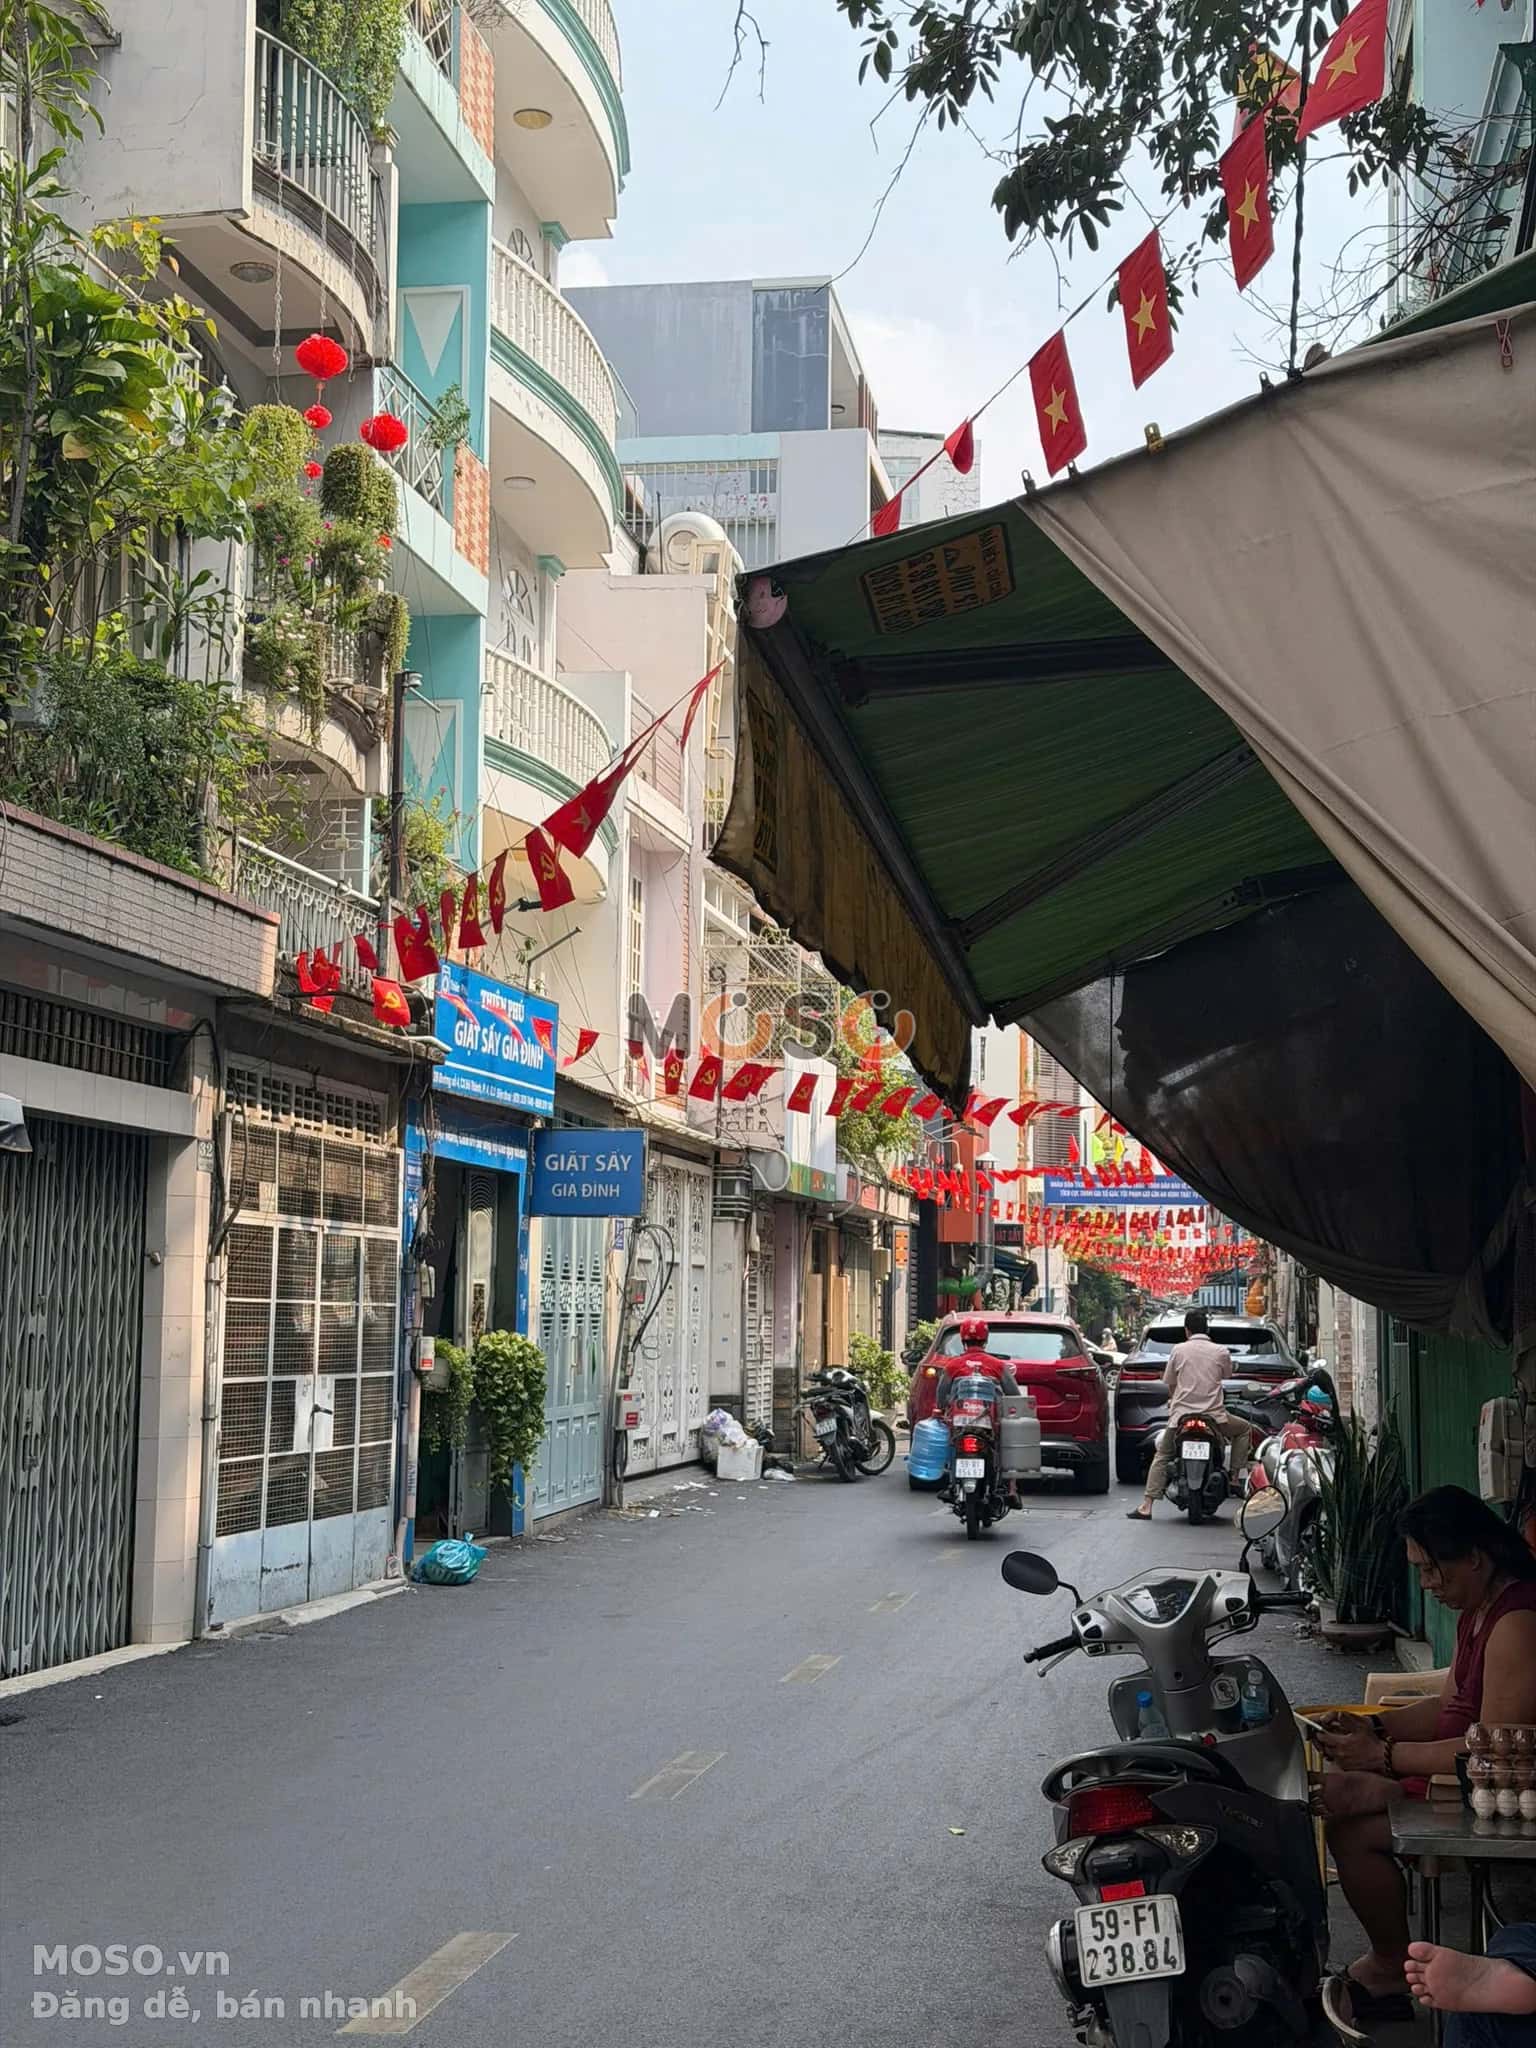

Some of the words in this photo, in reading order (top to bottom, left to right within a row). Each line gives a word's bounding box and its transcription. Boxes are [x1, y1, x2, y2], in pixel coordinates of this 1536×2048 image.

[481, 1023, 501, 1056] SẤY
[502, 1034, 520, 1062] GIA
[520, 1035, 544, 1070] ĐÌNH
[200, 1142, 213, 1157] 32
[544, 1152, 588, 1176] GIẶT
[595, 1150, 633, 1171] SẤY
[552, 1183, 577, 1197] GIA
[582, 1181, 620, 1197] ĐÌNH
[1091, 1902, 1160, 1941] 59-F1
[1086, 1937, 1177, 1980] 238.84
